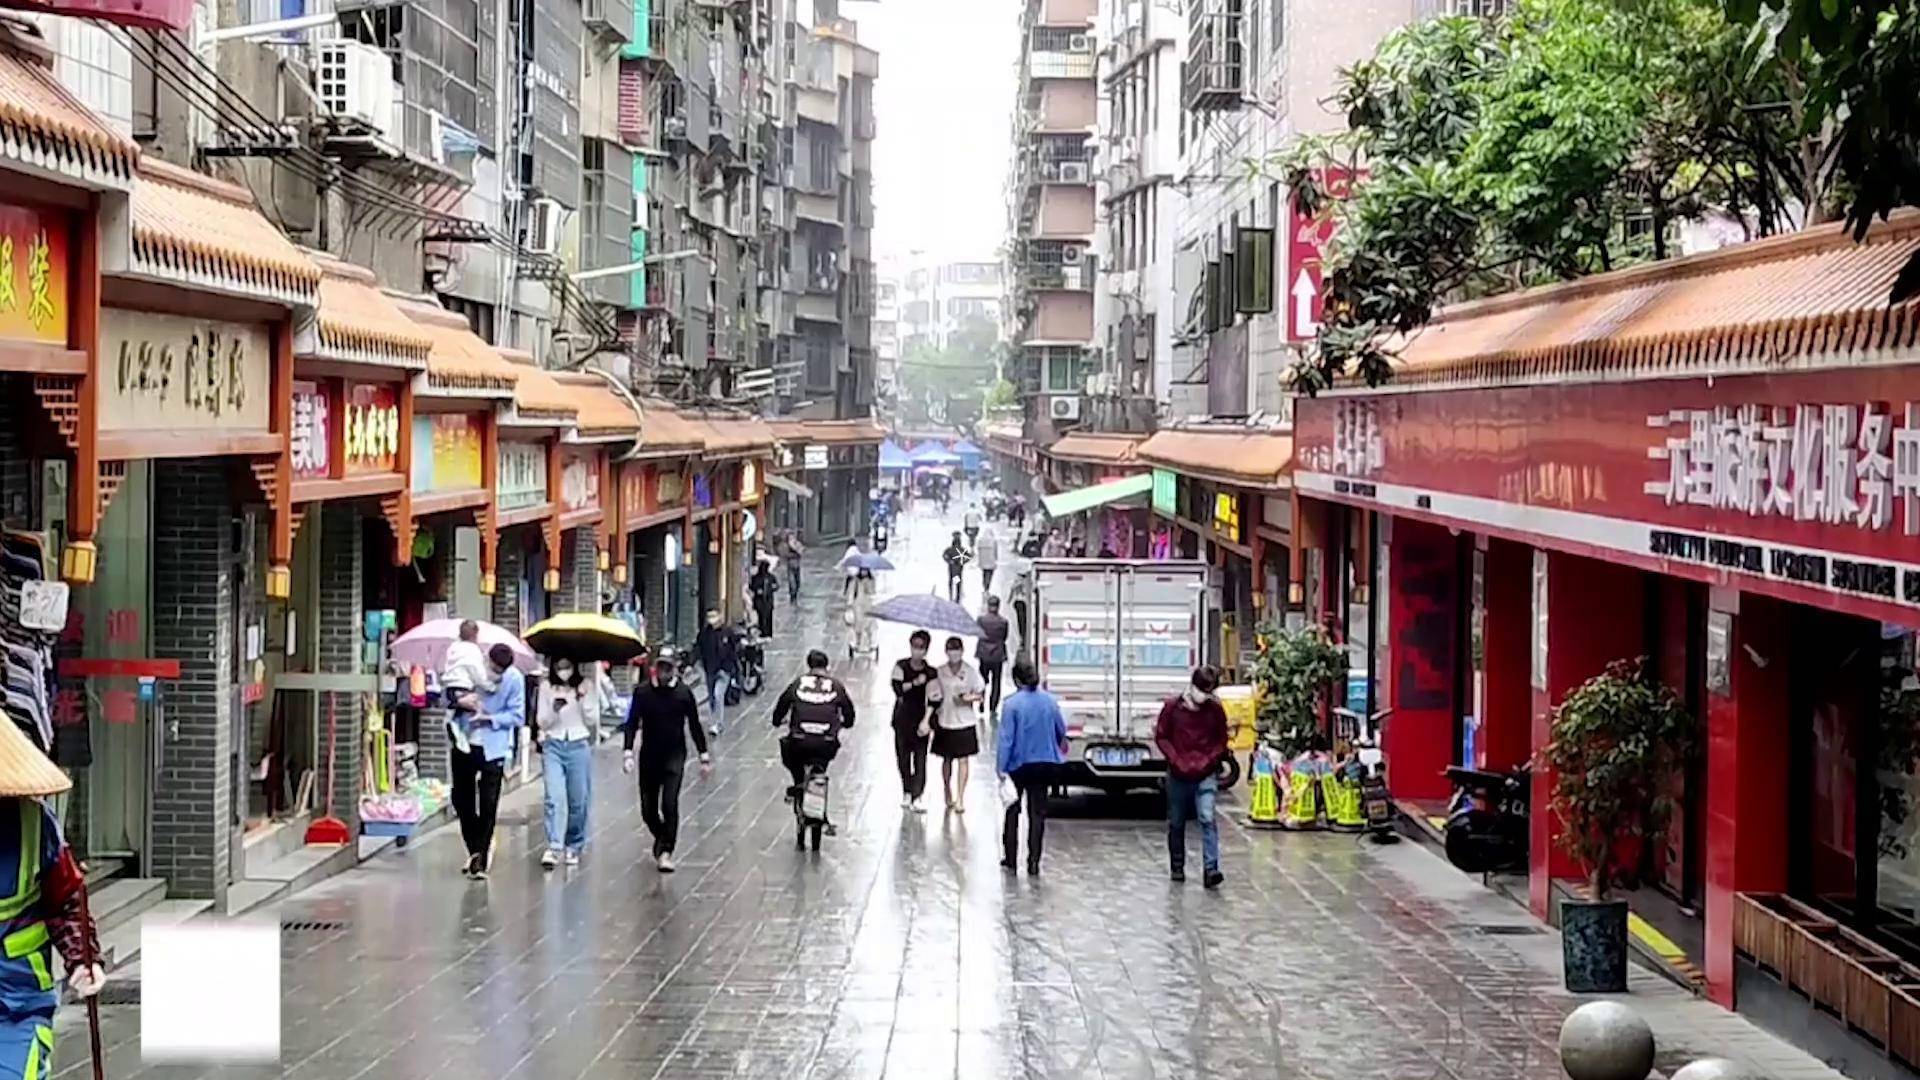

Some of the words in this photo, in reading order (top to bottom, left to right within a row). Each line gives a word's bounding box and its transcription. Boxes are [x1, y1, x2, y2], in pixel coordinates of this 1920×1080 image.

[1643, 401, 1920, 535] 三元里旅游文化服务中
